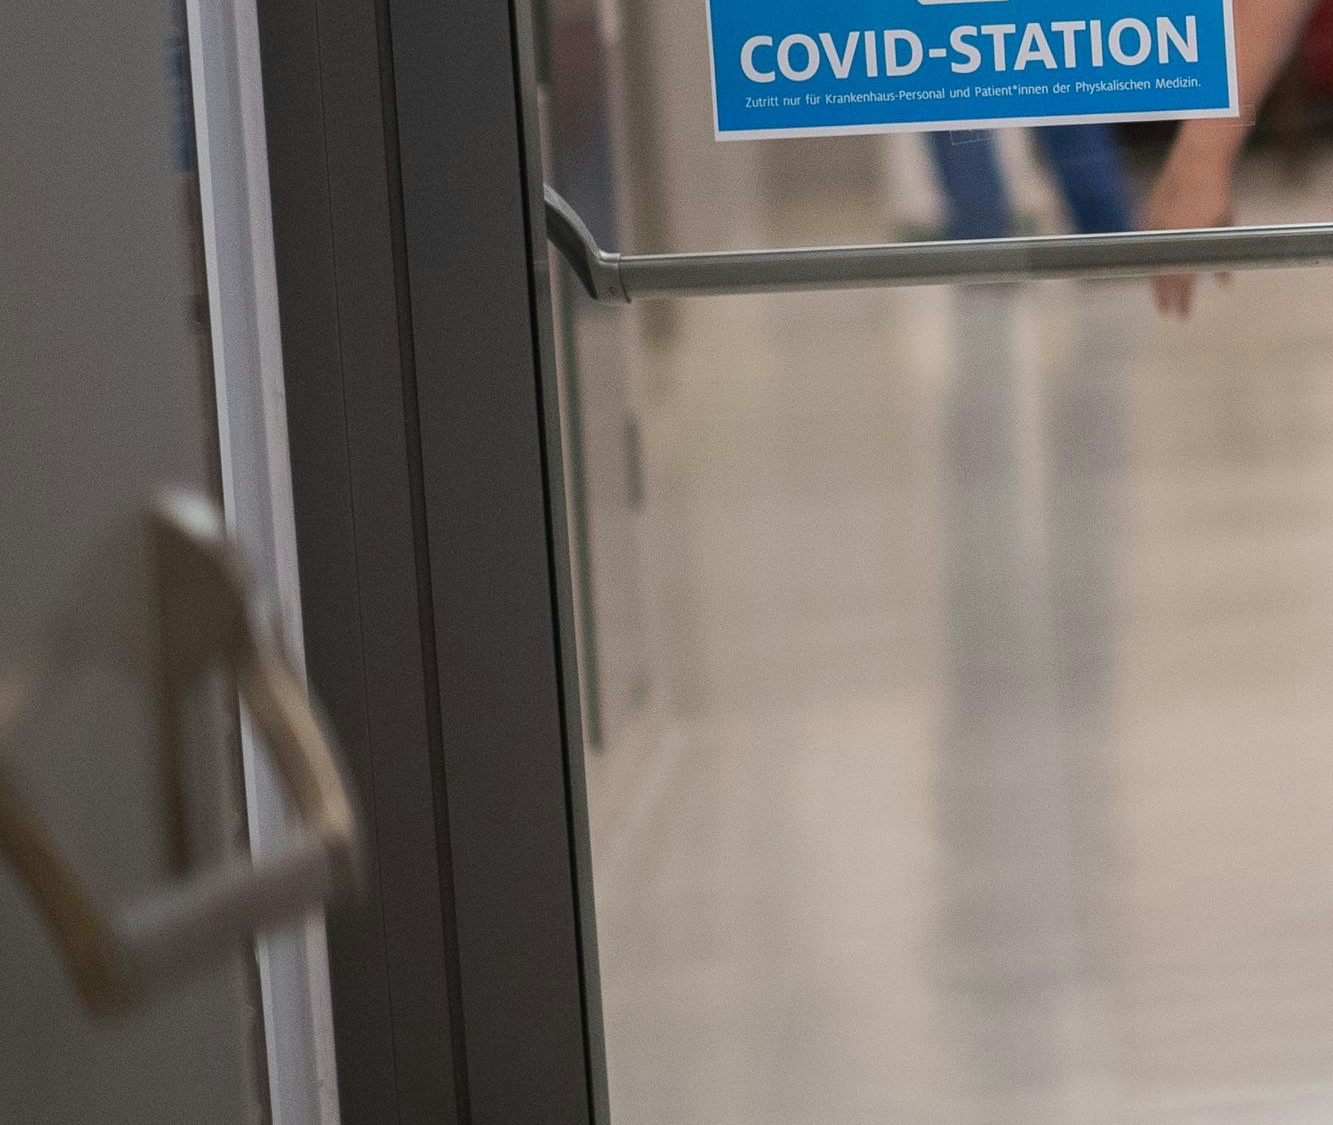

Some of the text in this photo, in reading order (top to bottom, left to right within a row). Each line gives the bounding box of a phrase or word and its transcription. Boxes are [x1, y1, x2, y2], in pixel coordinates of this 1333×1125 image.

[740, 15, 1199, 84] COVID-STATION
[746, 96, 778, 108] Zutritt
[783, 97, 801, 106] nur
[805, 94, 820, 105] für
[825, 87, 945, 104] Krankenhaus-Personal
[950, 86, 970, 98] und
[1053, 83, 1070, 94] der
[1155, 77, 1201, 89] Medizin.
